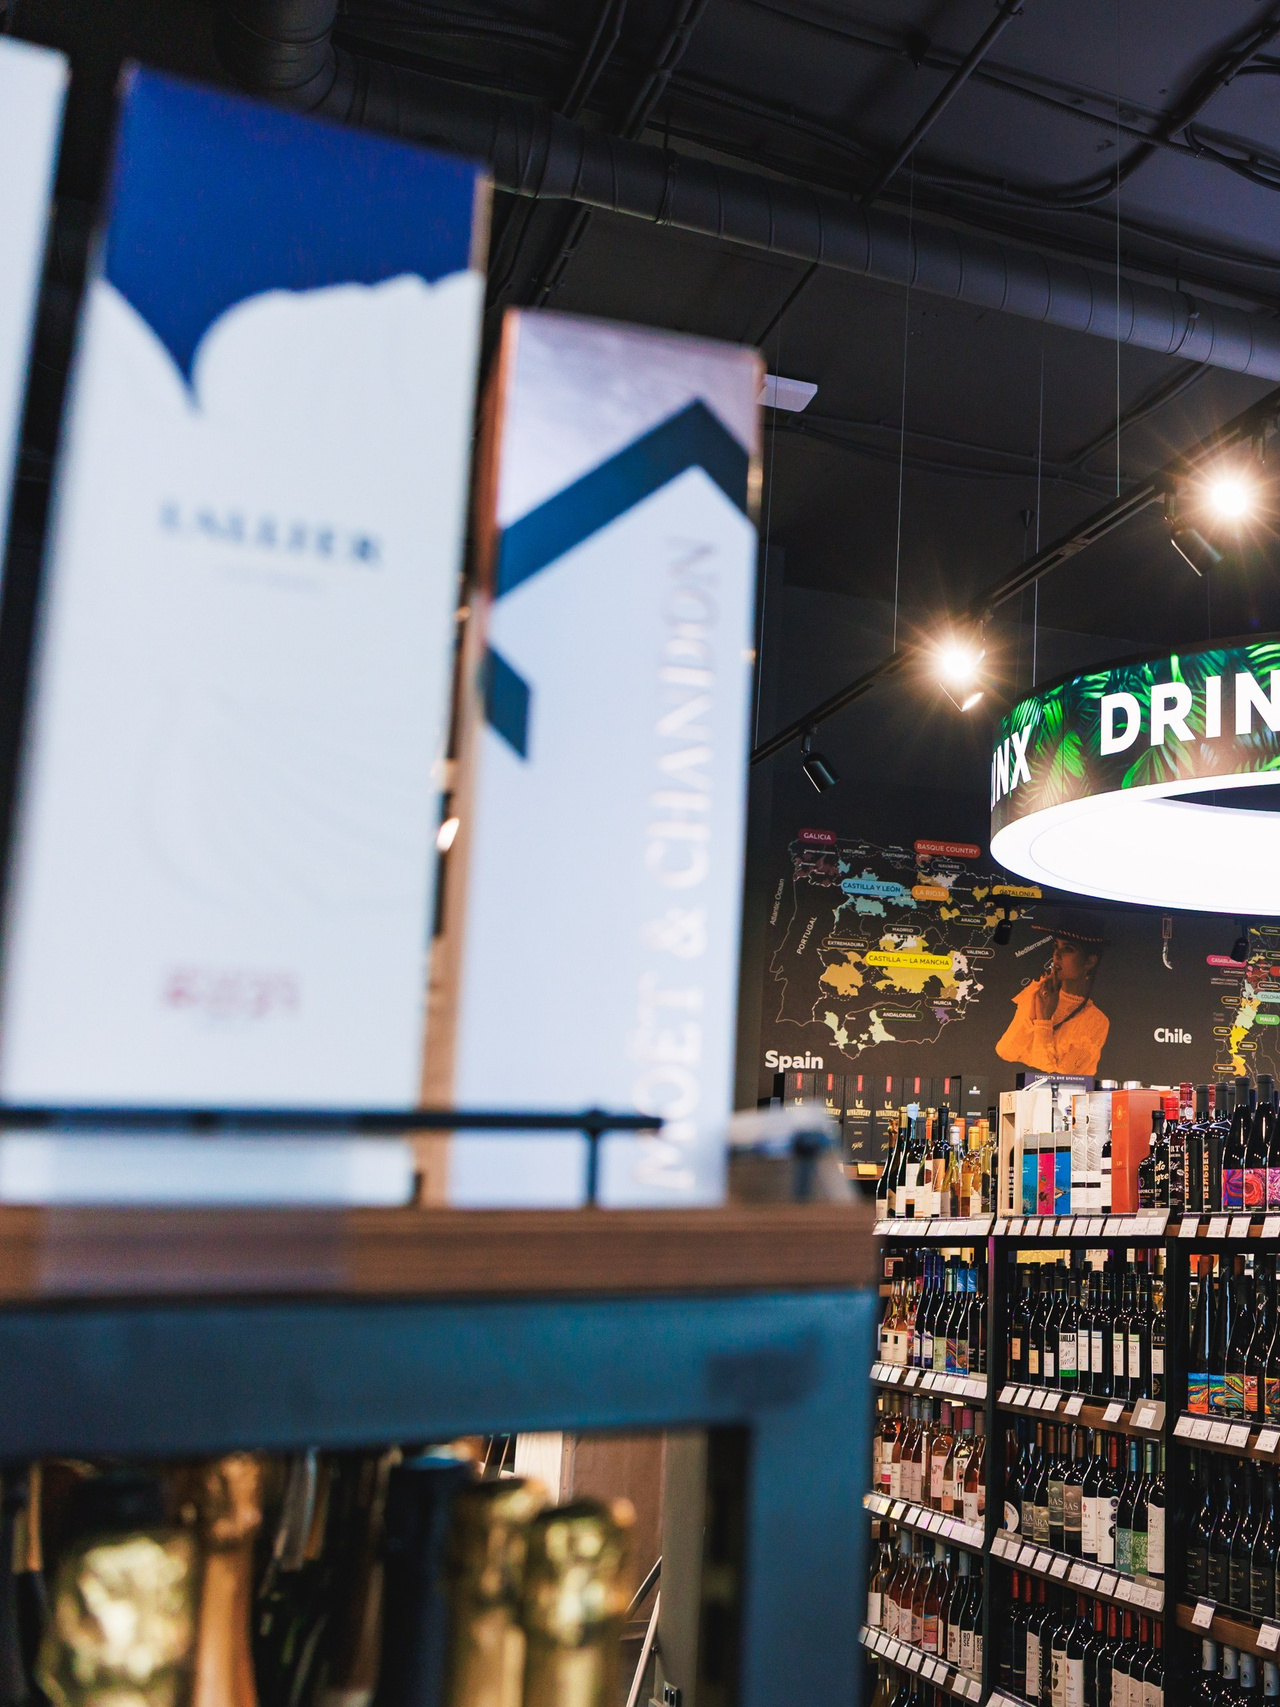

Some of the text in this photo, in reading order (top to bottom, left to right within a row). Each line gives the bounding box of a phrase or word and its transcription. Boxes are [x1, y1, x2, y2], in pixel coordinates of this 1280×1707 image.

[803, 832, 832, 841] GALICIA
[917, 843, 978, 855] BASQUE COUNTRY
[843, 882, 876, 891] CASTILLA
[881, 883, 901, 893] LEÓN
[925, 890, 946, 898] RIOJA
[770, 878, 785, 926] Atlantic Ocean
[796, 916, 818, 955] PORTUGAL
[1015, 935, 1054, 958] Mediterranean
[868, 955, 901, 963] CASTILLA
[919, 958, 950, 966] MANCHA
[1154, 1028, 1193, 1044] Chile
[765, 1050, 824, 1073] Spain
